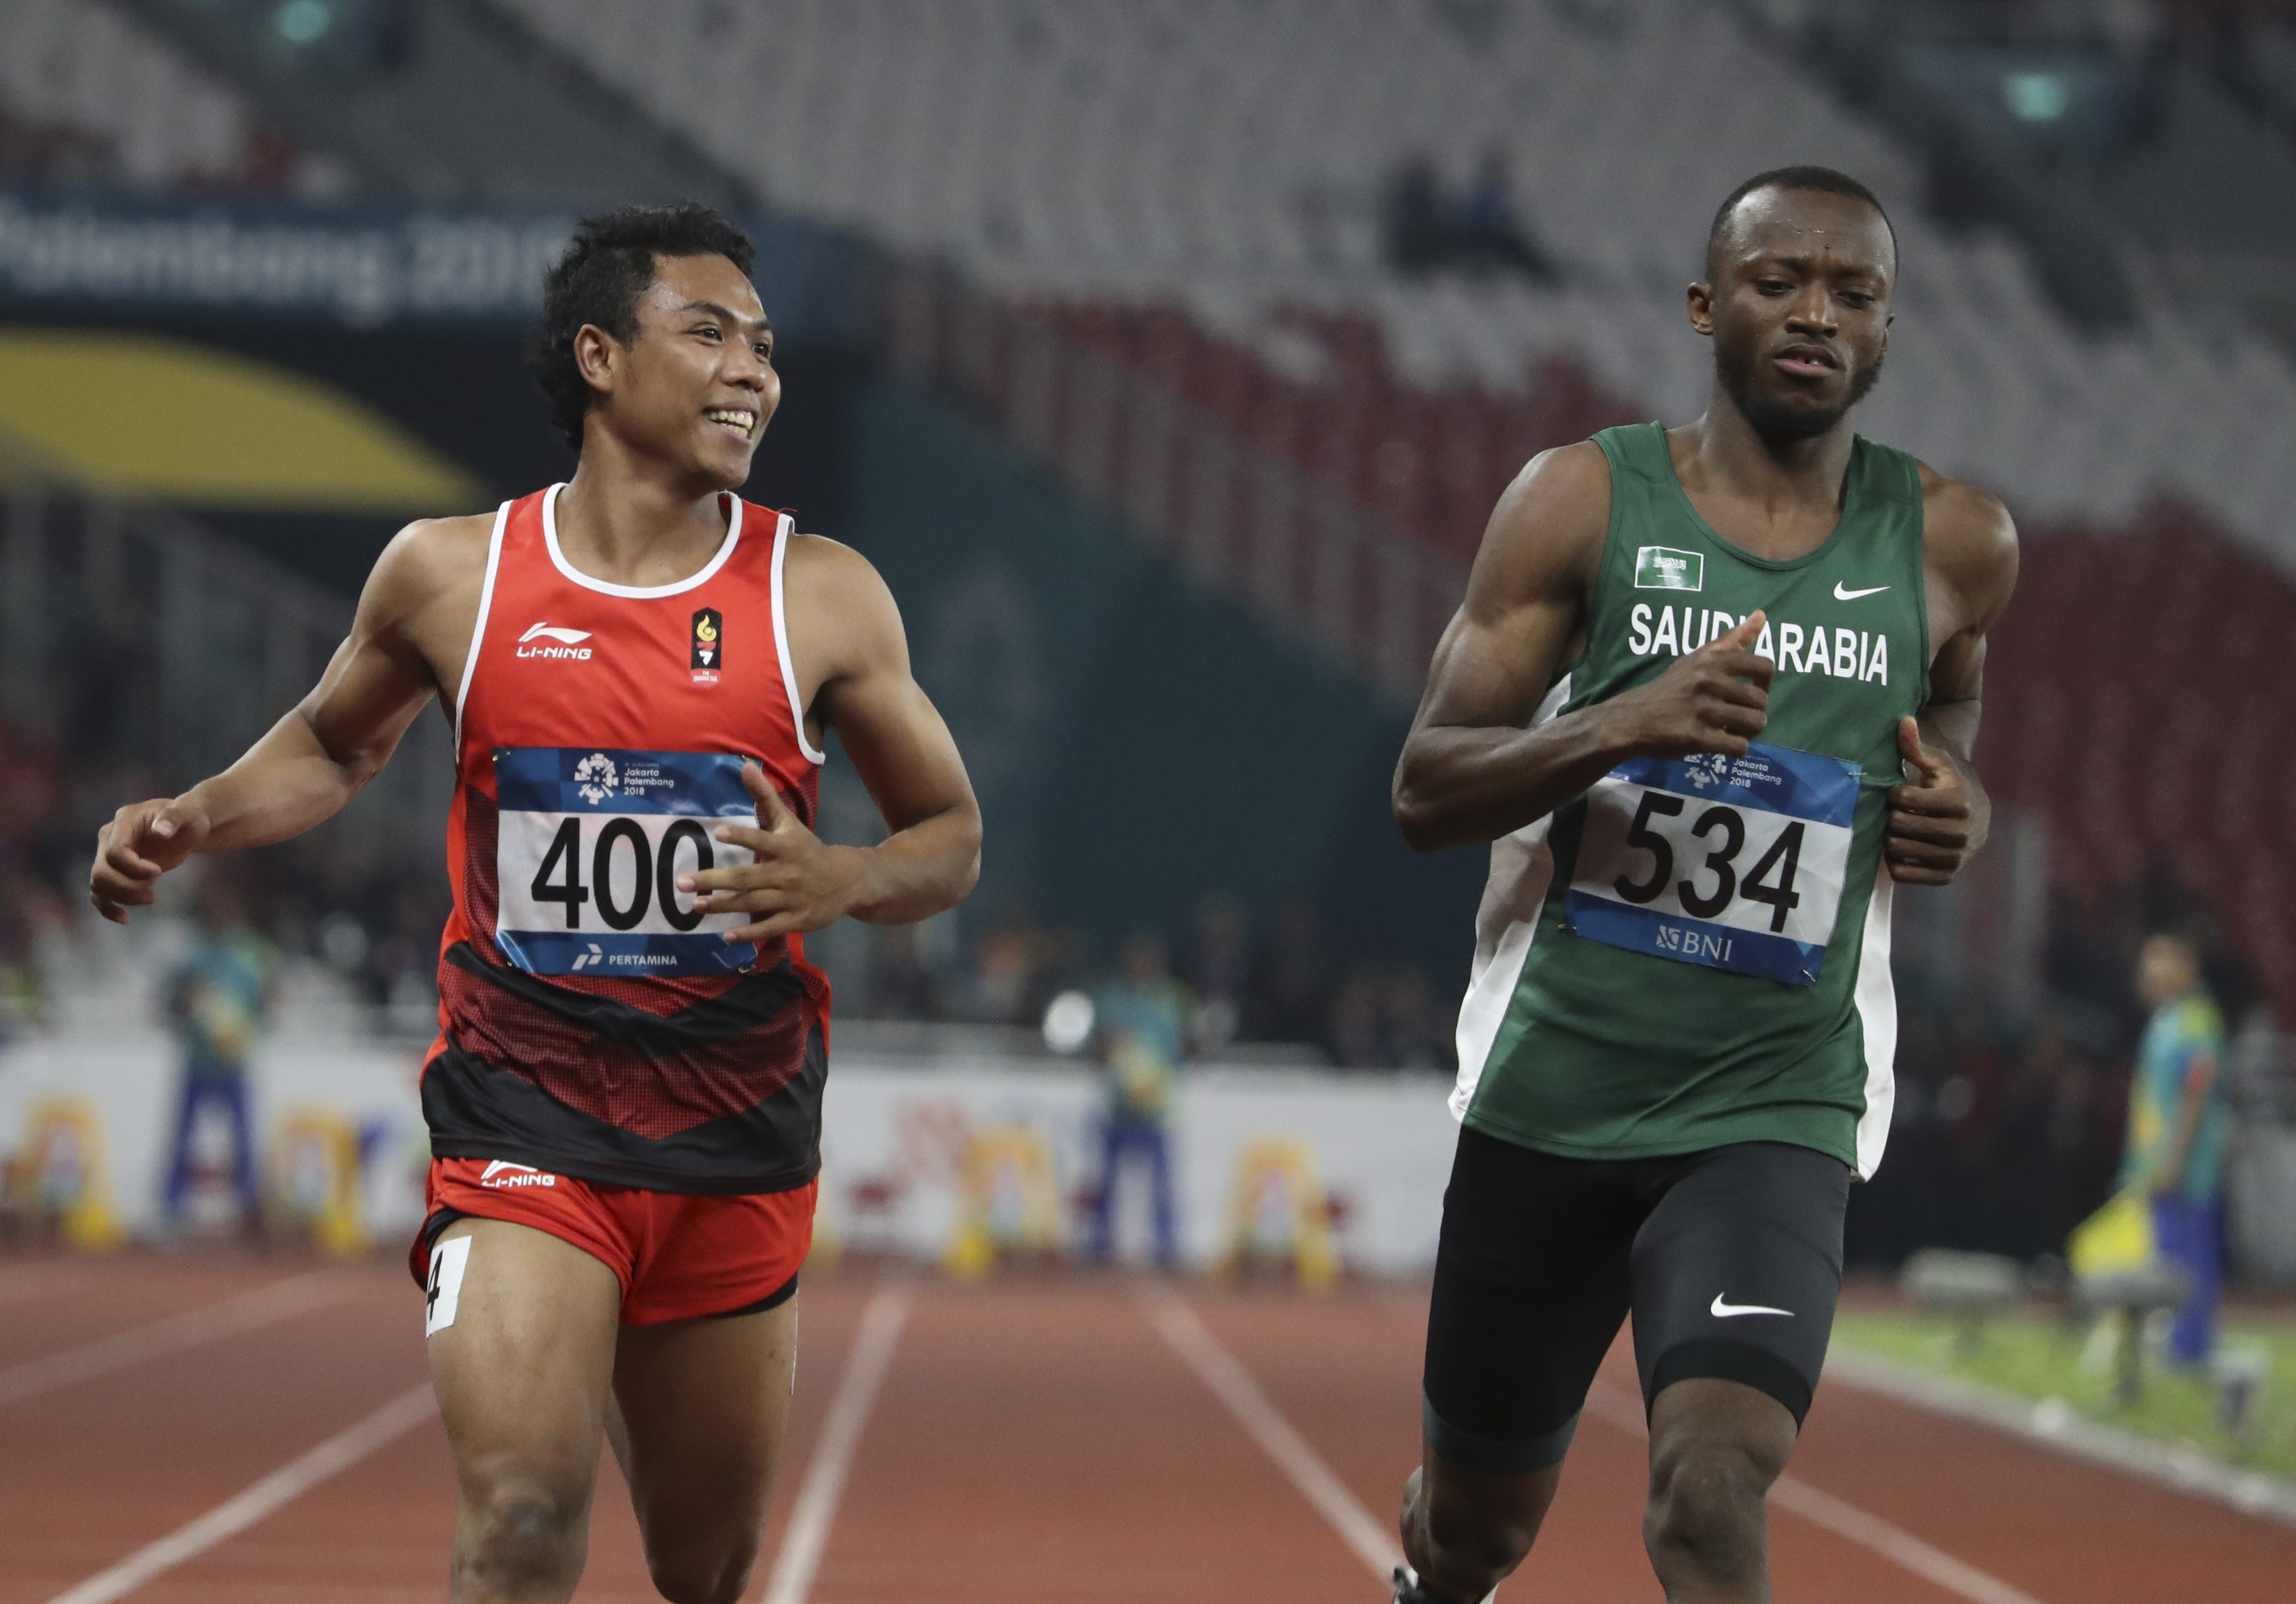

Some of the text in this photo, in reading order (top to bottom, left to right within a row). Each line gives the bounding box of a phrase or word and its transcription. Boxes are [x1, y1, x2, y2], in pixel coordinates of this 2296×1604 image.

[1629, 603, 1888, 686] SAUD ARABIA
[517, 646, 592, 660] LI-NING
[625, 768, 660, 776] Jakarta
[1733, 758, 1768, 772] Jakarta
[624, 777, 674, 788] Palembang
[1729, 777, 1751, 788] 2018
[1731, 766, 1782, 785] Palembang
[624, 786, 645, 795] 2018
[1614, 790, 1805, 933] 534
[531, 817, 713, 931] 400
[1682, 931, 1732, 962] BNI
[609, 955, 677, 965] PERTAMINA
[427, 1249, 443, 1322] 4
